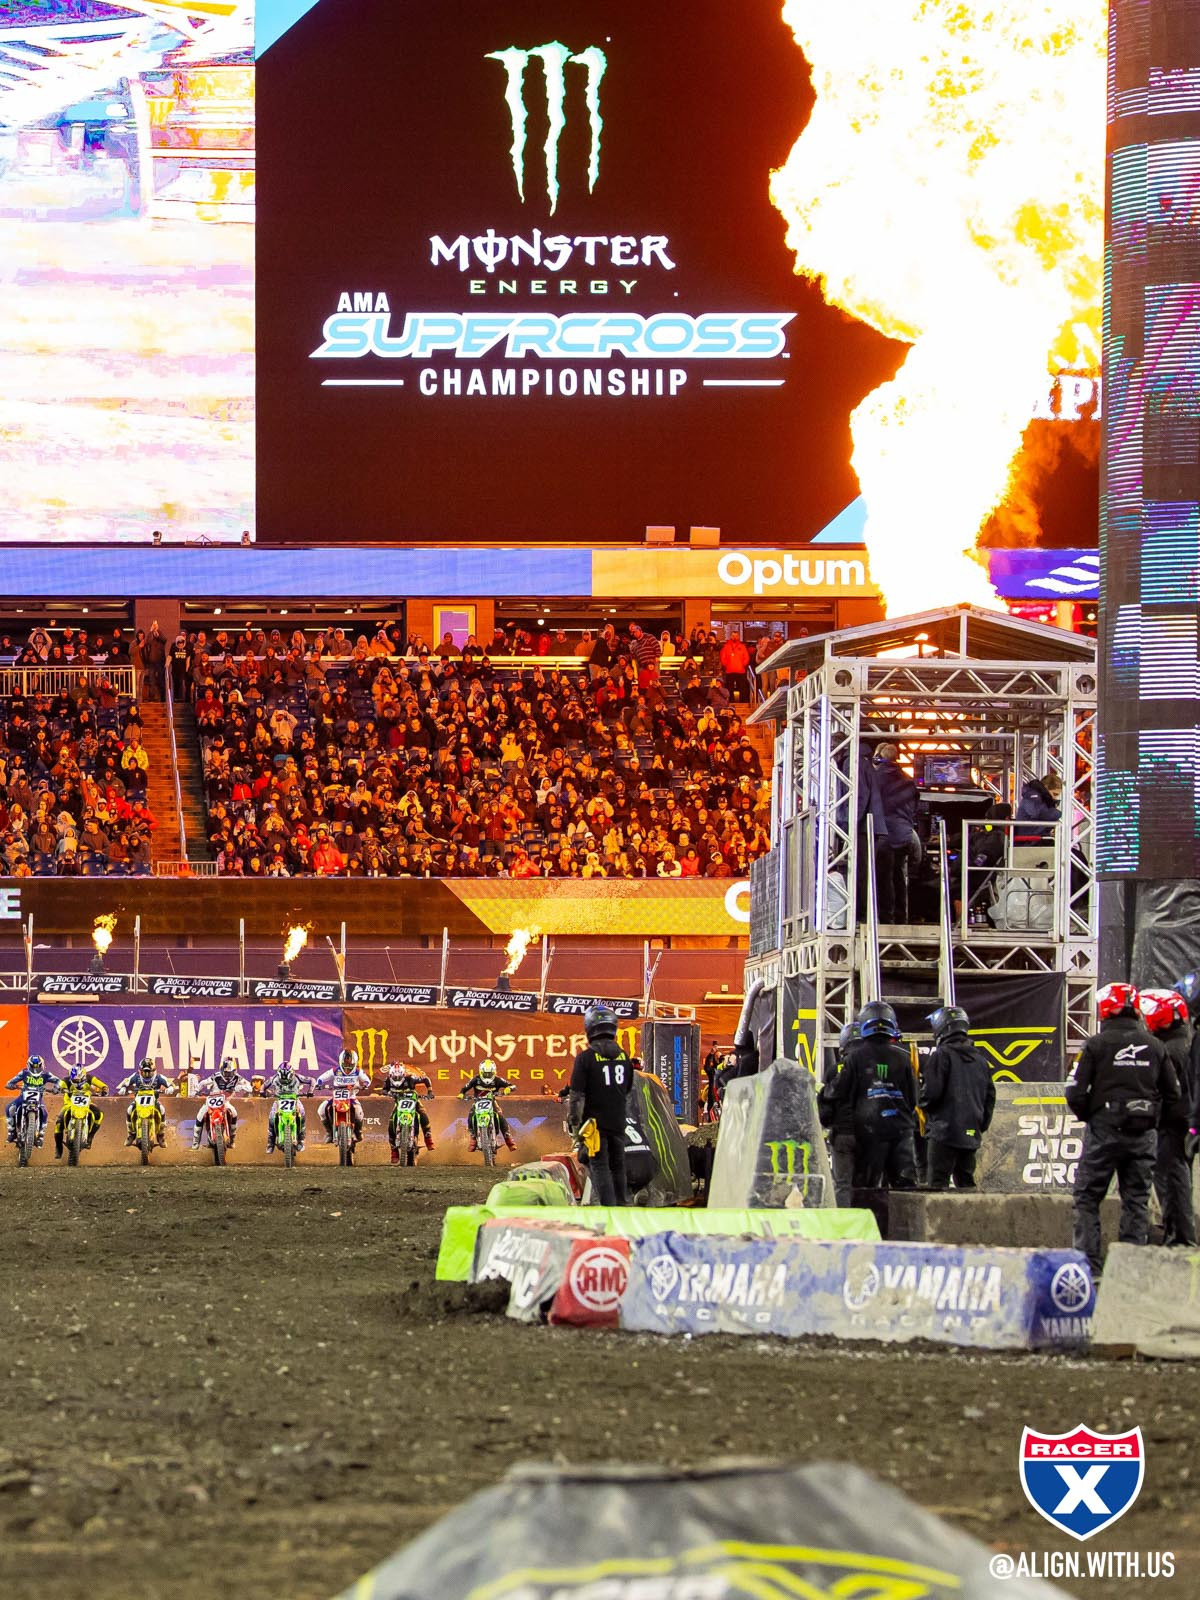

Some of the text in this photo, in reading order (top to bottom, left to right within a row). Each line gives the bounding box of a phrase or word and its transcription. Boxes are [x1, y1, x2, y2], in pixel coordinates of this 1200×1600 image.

[429, 228, 676, 273] MONSTER
[470, 280, 638, 294] ENERGY
[337, 292, 390, 312] AMA
[308, 313, 798, 358] SUPERCROSS
[419, 368, 687, 396] CHAMPIONSHIP
[717, 552, 864, 594] Optum
[192, 979, 232, 987] MOUNTAIN
[293, 983, 334, 991] MOUNTAIN
[391, 986, 432, 994] MOUNTAIN
[492, 993, 531, 1001] MOUNTAIN
[566, 997, 634, 1007] ROCKY MOUNTAIN
[113, 1020, 319, 1070] YAMAHA
[437, 1069, 566, 1080] ENRGY
[602, 1064, 625, 1086] 18
[26, 1091, 39, 1101] 2
[334, 1089, 349, 1098] 56
[73, 1096, 87, 1105] 94
[139, 1096, 152, 1105] 11
[208, 1098, 224, 1107] 96
[280, 1100, 295, 1110] 21
[400, 1101, 413, 1109] 81
[1017, 1114, 1086, 1136] SUP
[1028, 1138, 1083, 1160] MO
[584, 1266, 621, 1292] RM
[1040, 1317, 1093, 1337] YAMAH
